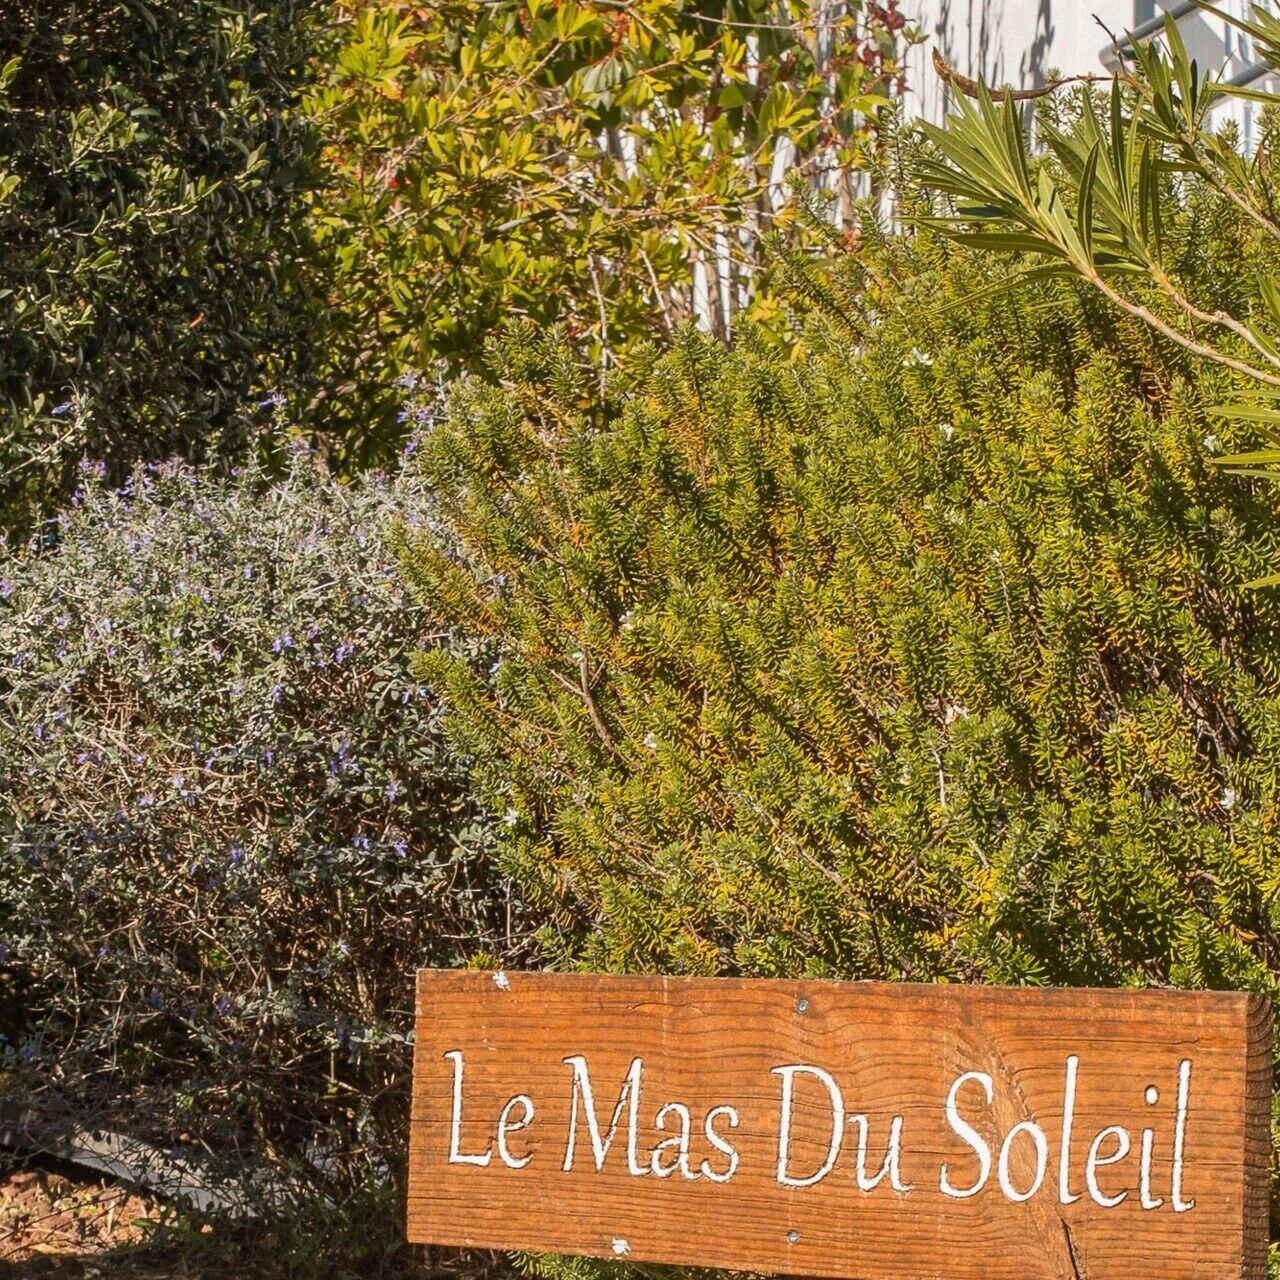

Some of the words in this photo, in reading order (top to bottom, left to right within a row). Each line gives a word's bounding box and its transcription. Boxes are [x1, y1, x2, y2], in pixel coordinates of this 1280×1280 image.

[444, 1050, 536, 1169] Le
[562, 1056, 740, 1184] Mas
[770, 1064, 915, 1193] Du
[939, 1055, 1195, 1213] Soleil
